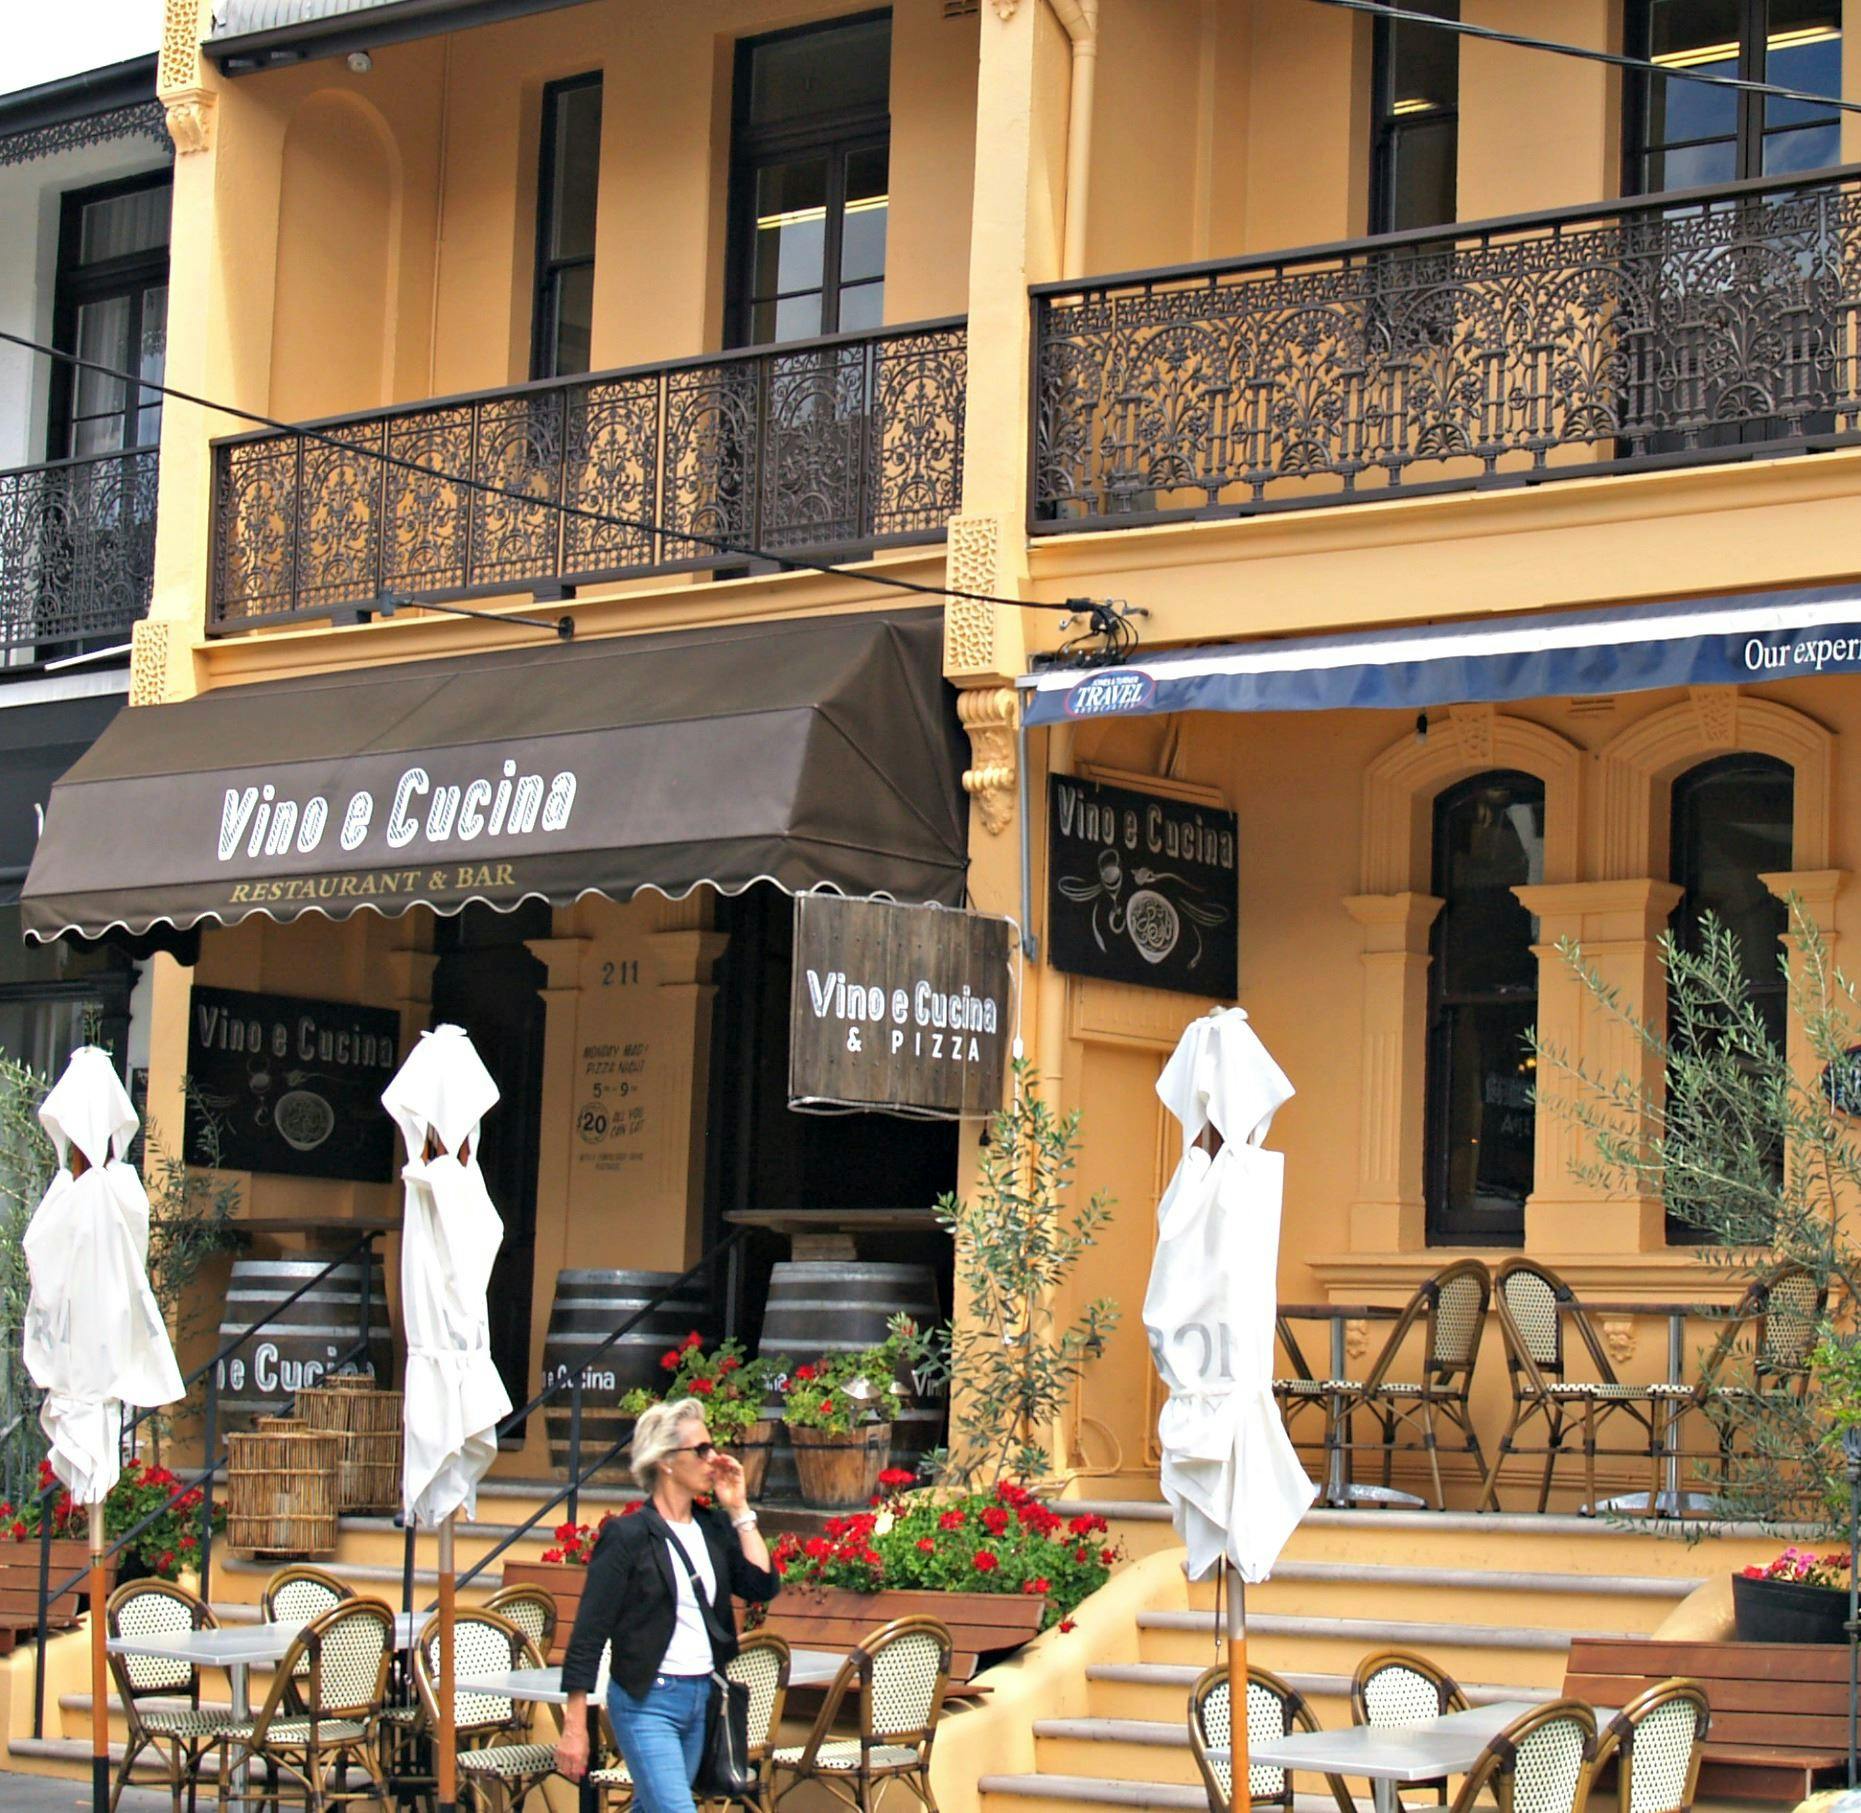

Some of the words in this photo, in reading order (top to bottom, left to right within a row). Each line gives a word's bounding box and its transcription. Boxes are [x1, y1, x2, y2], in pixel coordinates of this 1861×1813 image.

[1745, 639, 1791, 670] Our
[1793, 638, 1861, 671] exper
[1076, 683, 1144, 708] TRAVEL
[217, 784, 329, 861] Vino
[340, 790, 374, 851] e
[386, 759, 577, 848] Cucina
[1058, 784, 1115, 845] Vino
[1124, 810, 1138, 850] e
[1146, 803, 1234, 868] Cucina
[230, 872, 421, 903] RESTAURANT
[429, 870, 448, 891] &
[455, 863, 516, 888] BAR
[602, 960, 639, 987] 211
[806, 969, 886, 1021] Vino
[892, 989, 909, 1024] e
[915, 980, 997, 1034] Cucina
[199, 1004, 262, 1053] Vino
[272, 1022, 288, 1057] e
[298, 1015, 393, 1068] Cucina
[846, 1026, 862, 1052] &
[891, 1029, 980, 1062] PIZZA
[230, 1359, 245, 1391] e
[254, 1343, 376, 1392] Cuc
